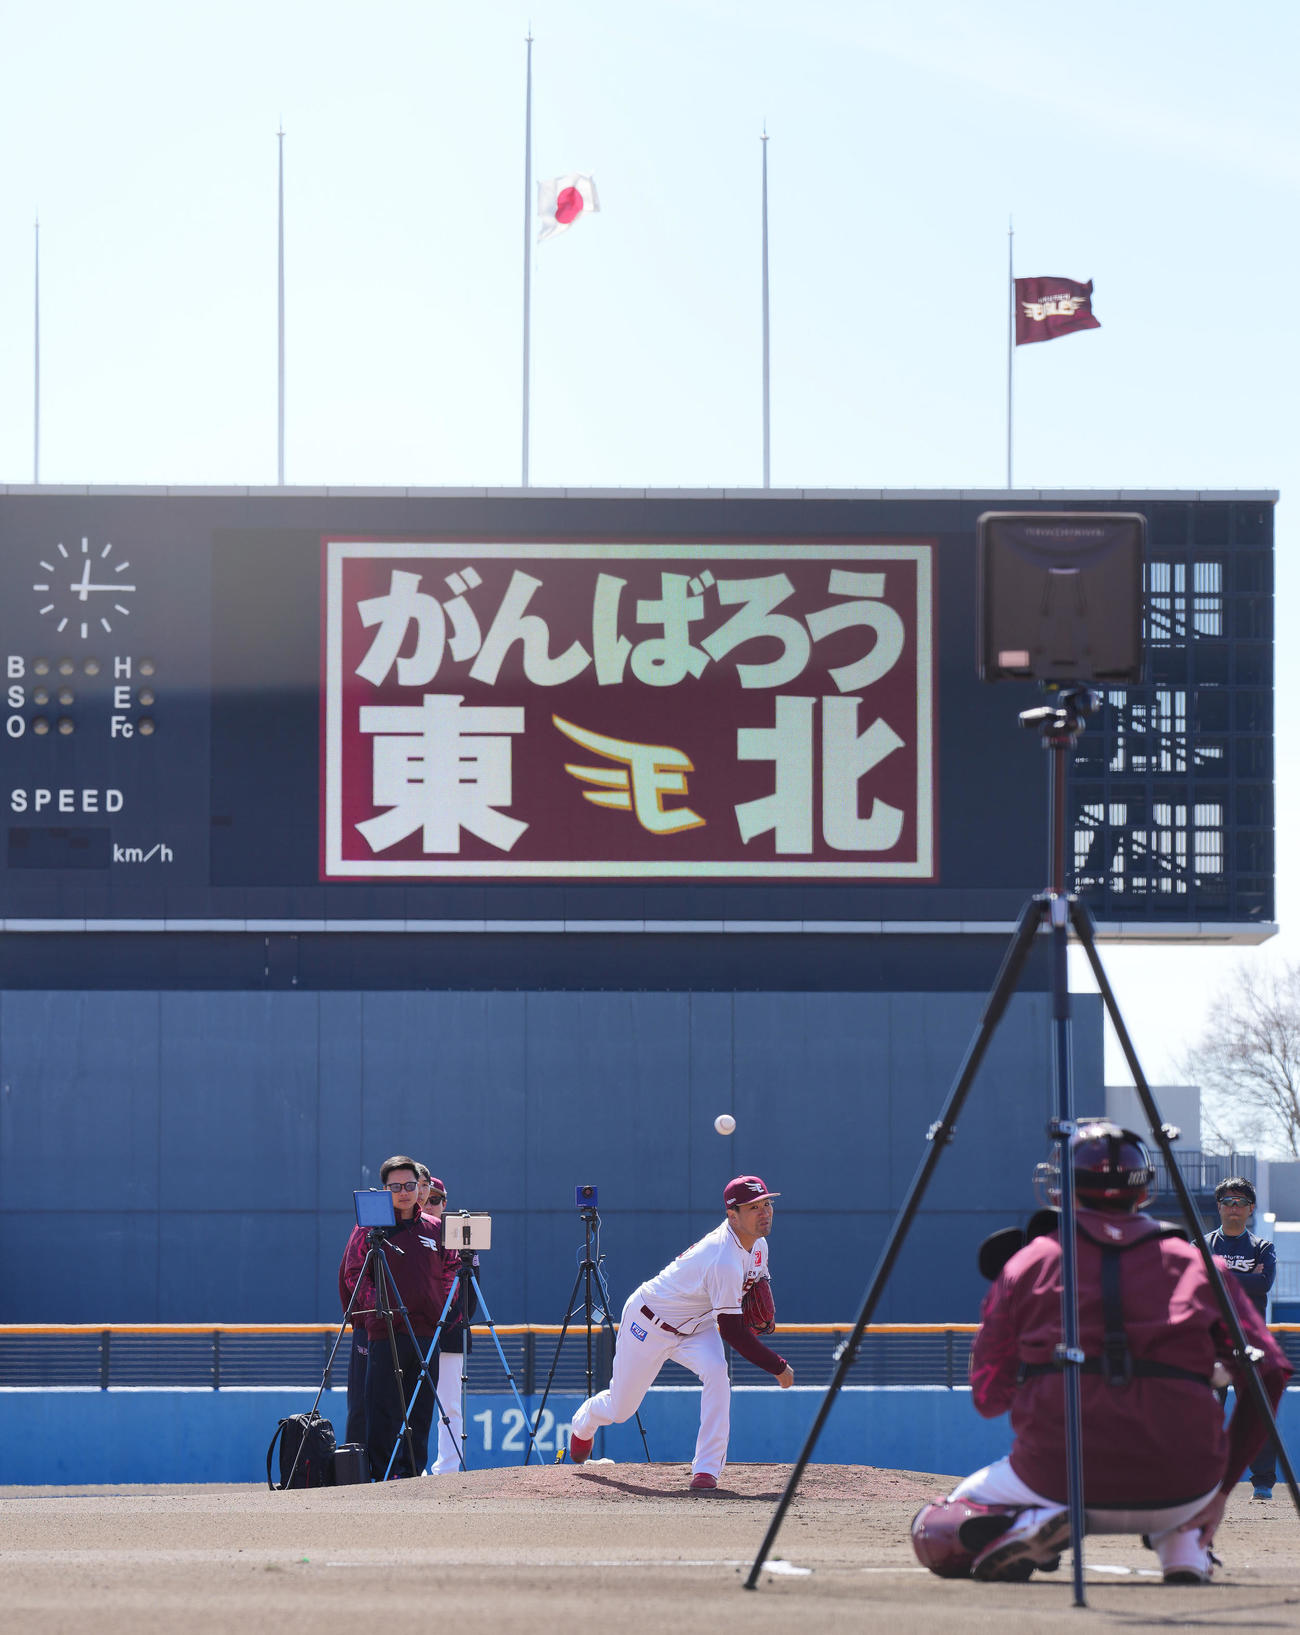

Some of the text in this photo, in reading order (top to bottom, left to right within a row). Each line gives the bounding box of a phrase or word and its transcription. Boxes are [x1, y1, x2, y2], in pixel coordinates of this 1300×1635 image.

[354, 565, 906, 693] がんばろう
[7, 655, 26, 678] B
[113, 656, 132, 679] H
[7, 685, 26, 708] S
[113, 685, 132, 709] E
[110, 715, 134, 738] Fc
[10, 788, 124, 812] SPEED
[112, 843, 174, 863] km/h
